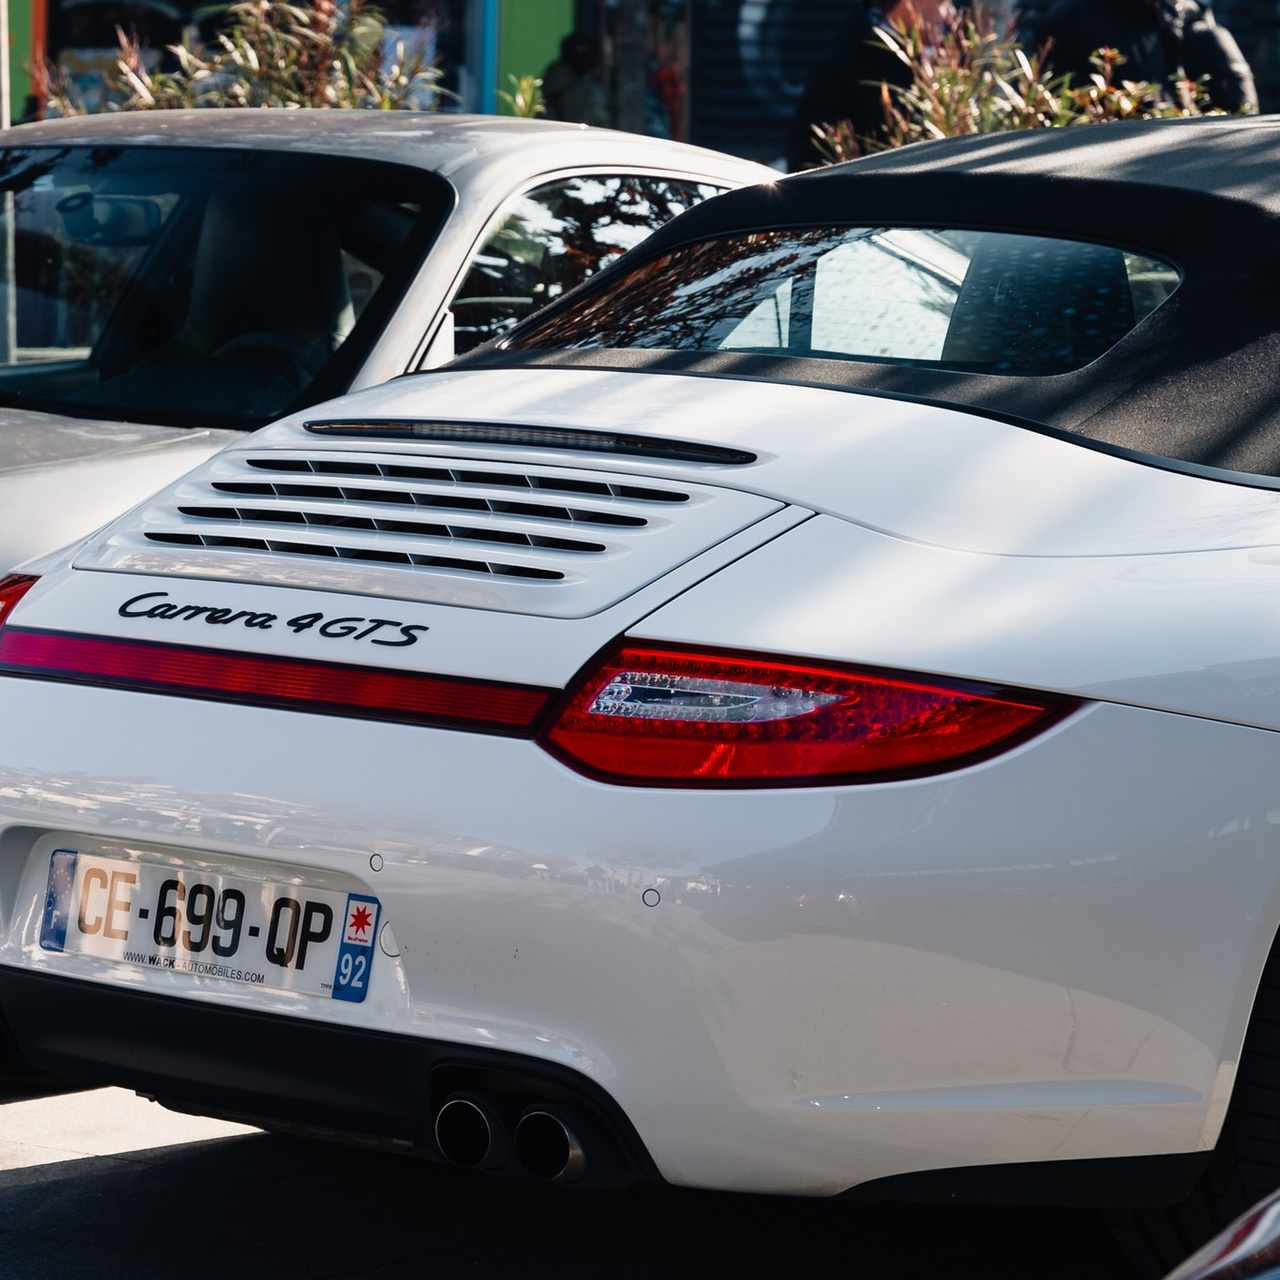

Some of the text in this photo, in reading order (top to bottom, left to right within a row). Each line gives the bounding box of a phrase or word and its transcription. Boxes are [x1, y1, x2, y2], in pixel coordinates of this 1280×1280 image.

[118, 591, 278, 630] Carrera
[50, 909, 61, 930] F
[339, 953, 367, 989] 92
